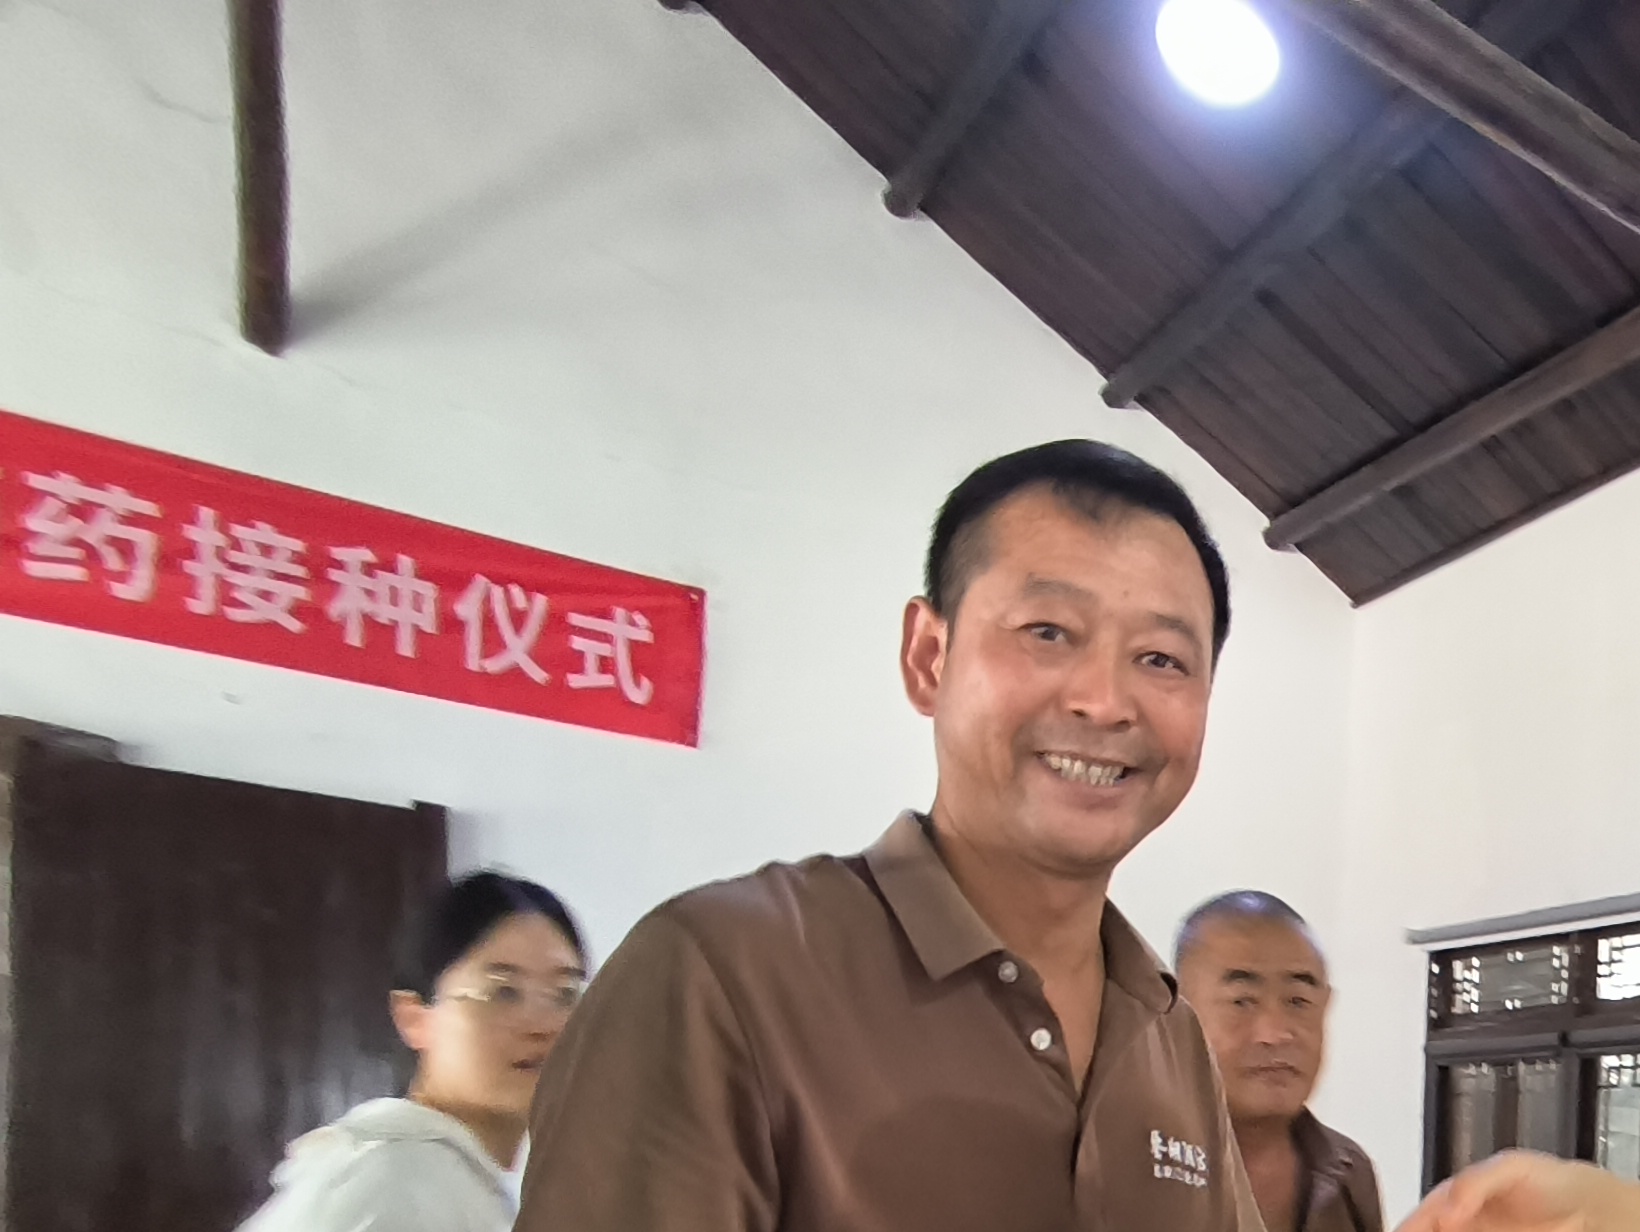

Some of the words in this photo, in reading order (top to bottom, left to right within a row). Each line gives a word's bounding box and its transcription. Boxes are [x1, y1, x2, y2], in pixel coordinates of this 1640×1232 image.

[20, 470, 654, 705] 药接种仪式
